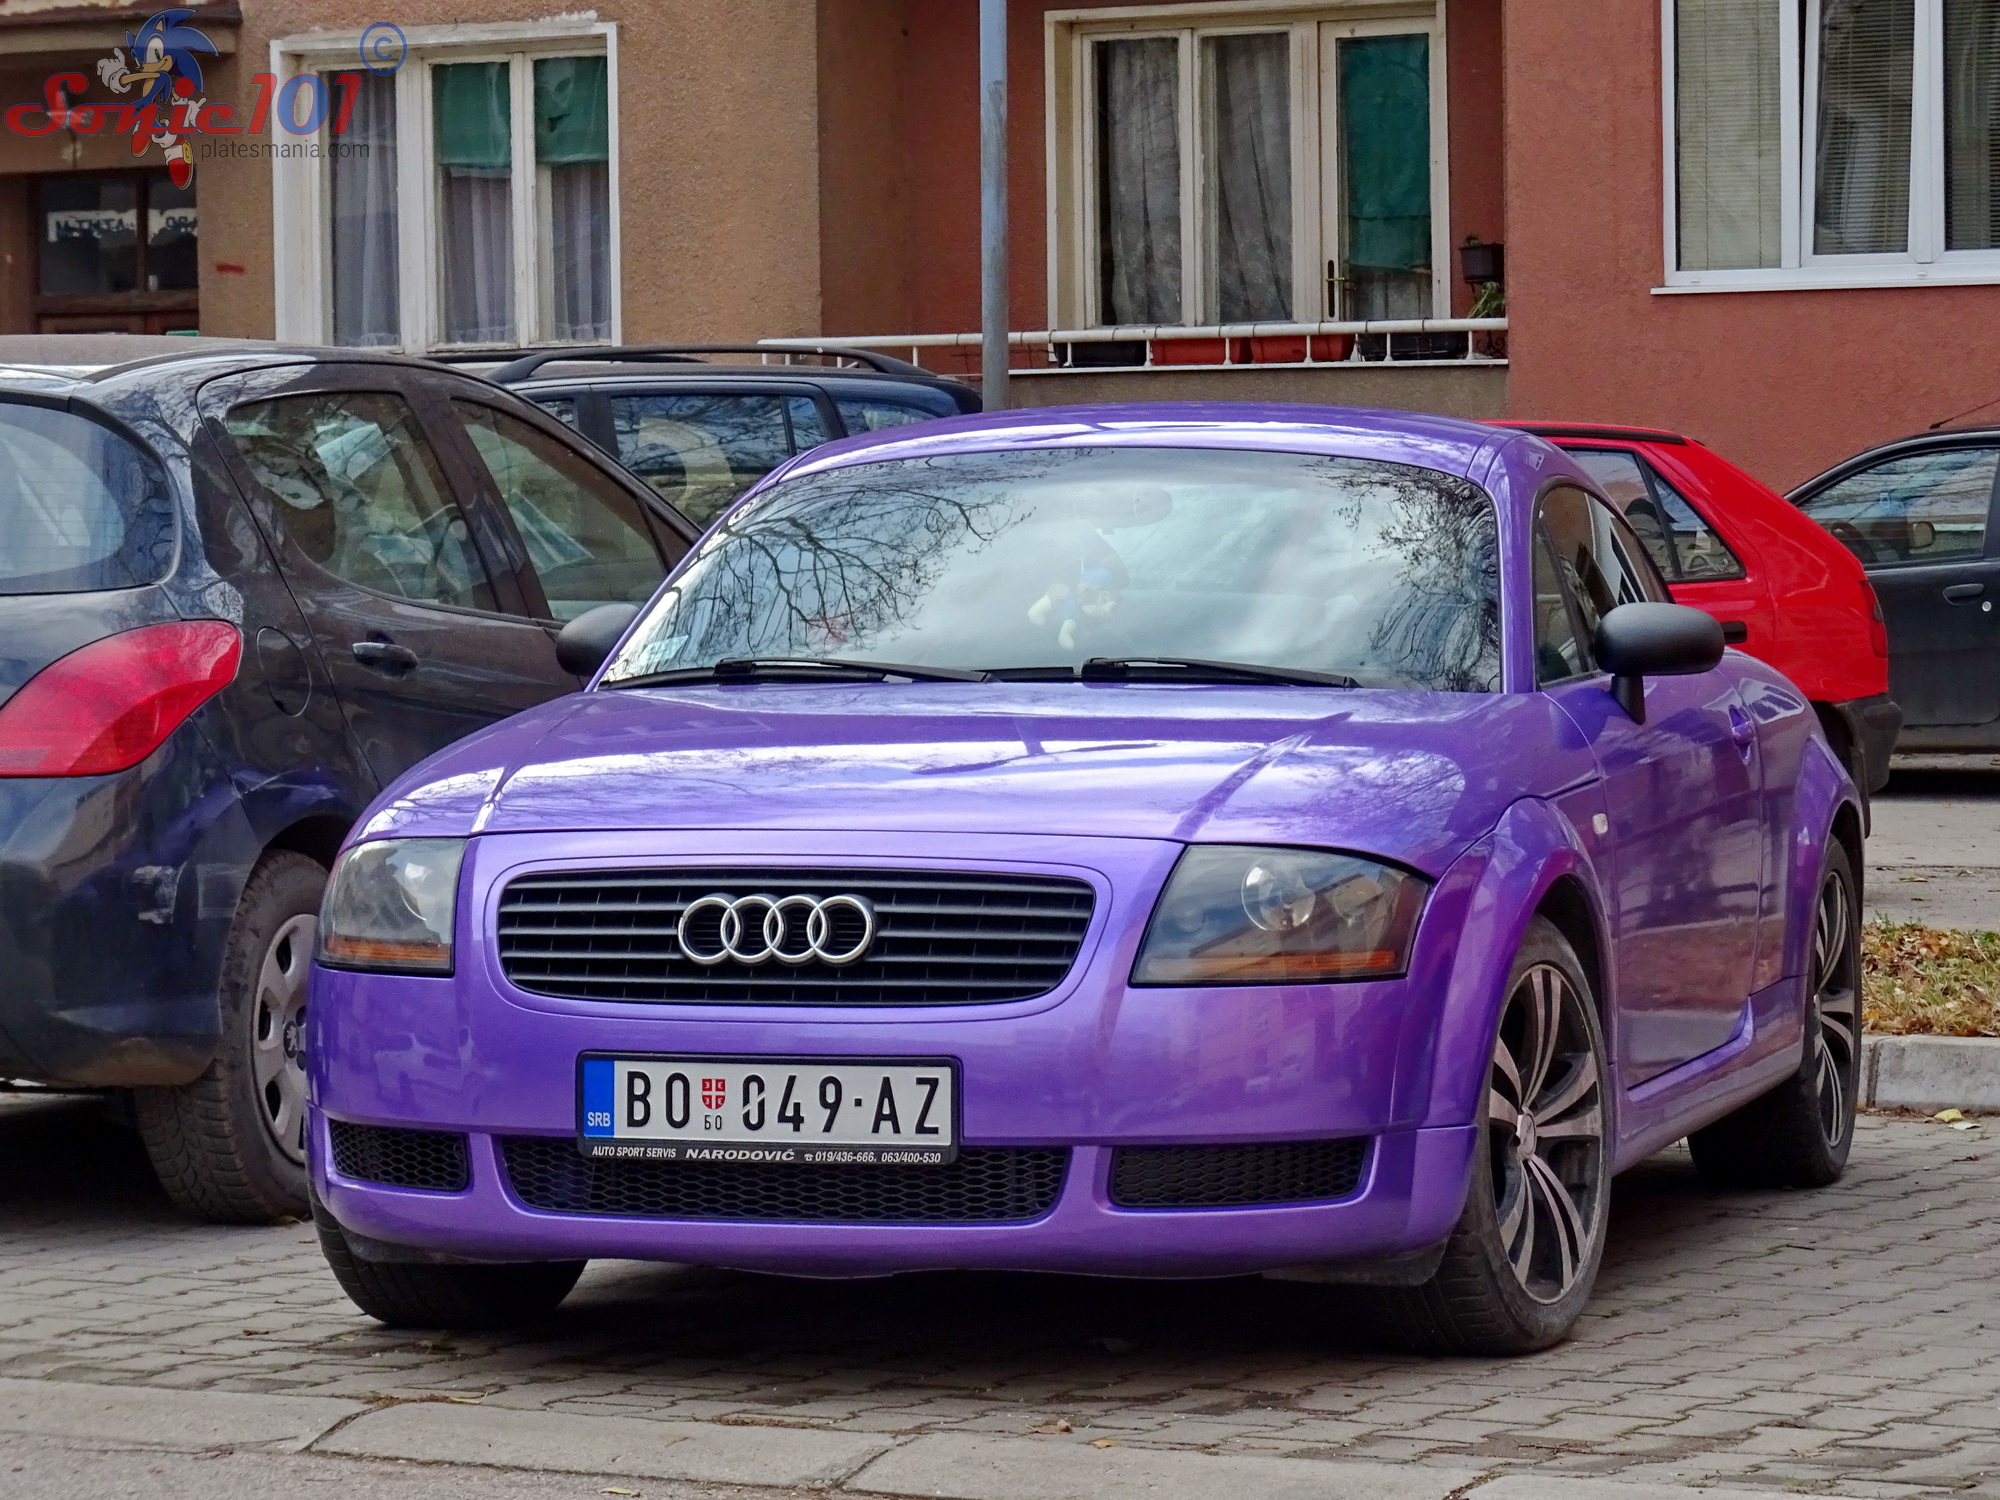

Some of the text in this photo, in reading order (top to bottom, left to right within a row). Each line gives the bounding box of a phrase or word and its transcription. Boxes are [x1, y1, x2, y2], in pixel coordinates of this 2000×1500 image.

[626, 1070, 690, 1129] BO
[587, 1111, 611, 1127] SRB
[592, 1145, 615, 1157] AUTO
[616, 1146, 644, 1158] SPORT
[645, 1147, 676, 1158] SERVIS
[685, 1148, 795, 1162] NARODOVIĆ
[881, 1151, 941, 1164] 063/400-530
